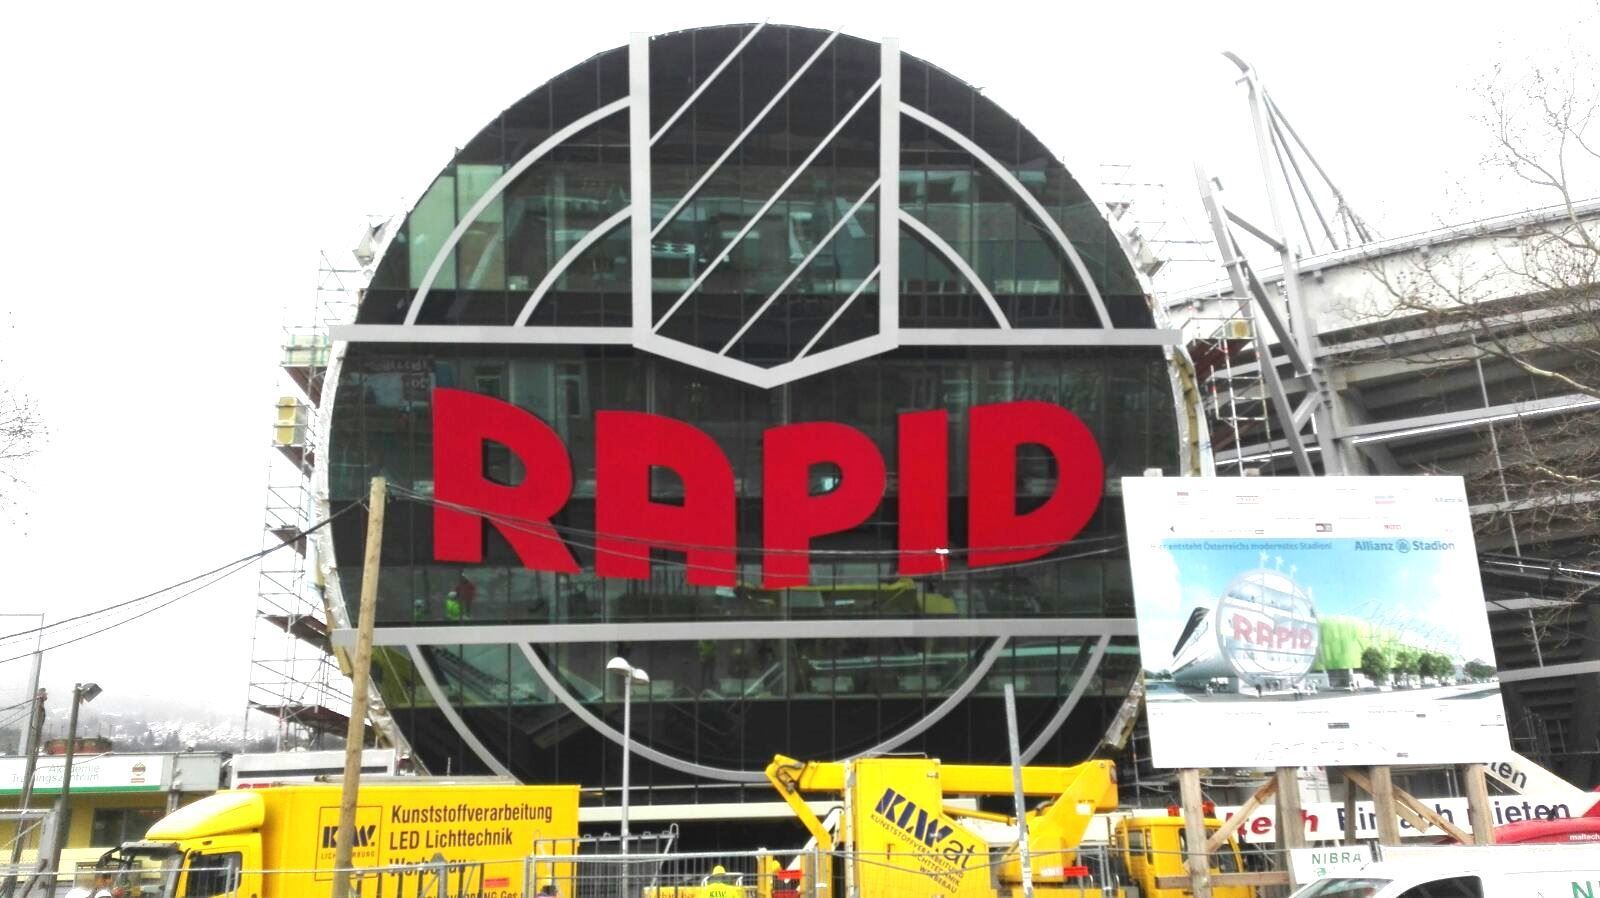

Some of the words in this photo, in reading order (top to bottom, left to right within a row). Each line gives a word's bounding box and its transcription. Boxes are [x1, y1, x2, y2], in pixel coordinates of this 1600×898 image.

[433, 387, 1103, 590] RAPID
[1355, 540, 1394, 551] Allianz
[1412, 540, 1455, 551] Stadion
[1232, 613, 1313, 650] RAPID
[391, 803, 553, 824] Kunststoffverarbeitung
[389, 831, 420, 851] LED
[426, 827, 513, 849] Lichttechnik
[1311, 852, 1362, 865] NIBRA
